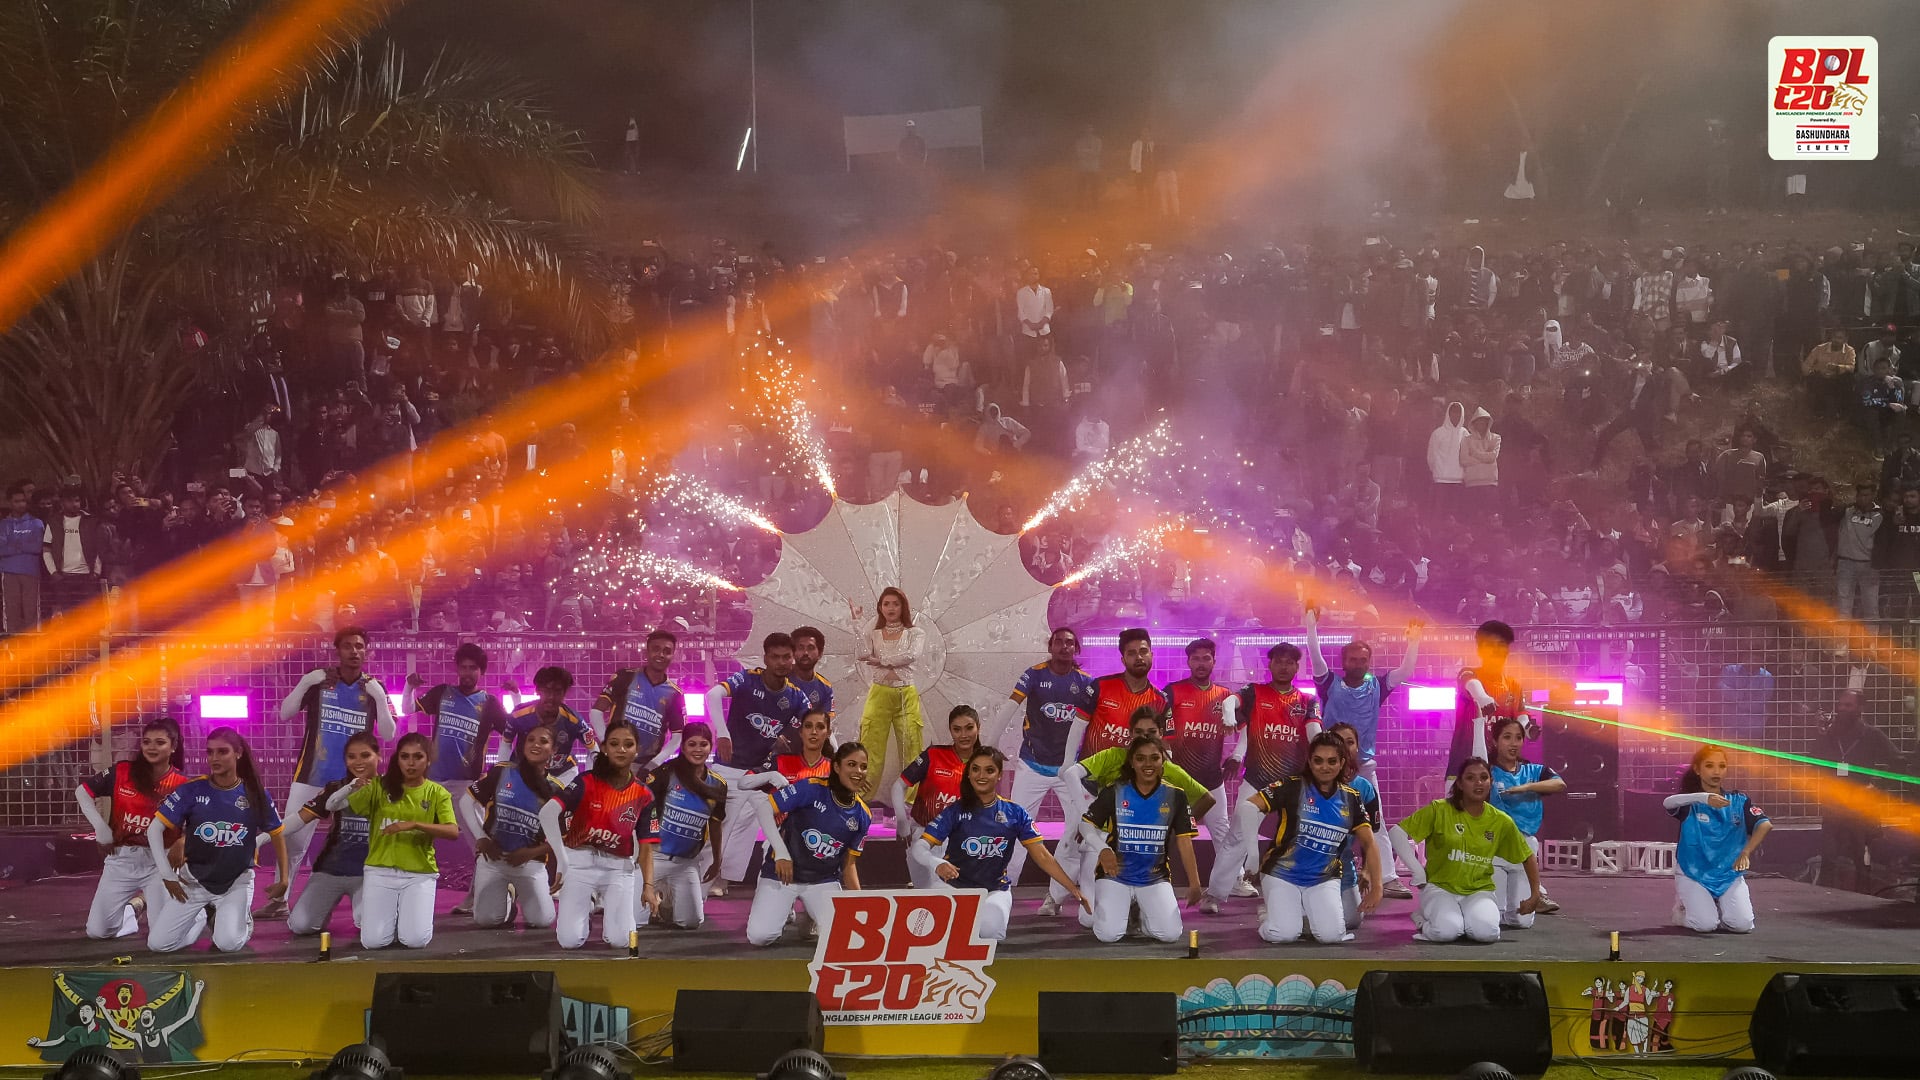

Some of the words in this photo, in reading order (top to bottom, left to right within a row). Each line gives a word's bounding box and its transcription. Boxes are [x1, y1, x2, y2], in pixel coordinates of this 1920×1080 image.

[1105, 723, 1130, 738] NAB
[1185, 721, 1218, 734] NABIL
[1265, 723, 1300, 737] NABIL
[1102, 732, 1131, 746] GROU
[124, 812, 151, 827] NAB
[196, 821, 248, 847] Orix
[1118, 827, 1166, 840] ASHUNDHAR
[802, 828, 843, 859] Orix
[961, 836, 1008, 860] Orix
[823, 895, 990, 963] BPL
[815, 963, 927, 1011] t20
[824, 1013, 870, 1022] NGLADESH
[872, 1013, 908, 1022] PREMIER
[909, 1013, 942, 1021] LEAGUE
[943, 1012, 964, 1020] 2026
